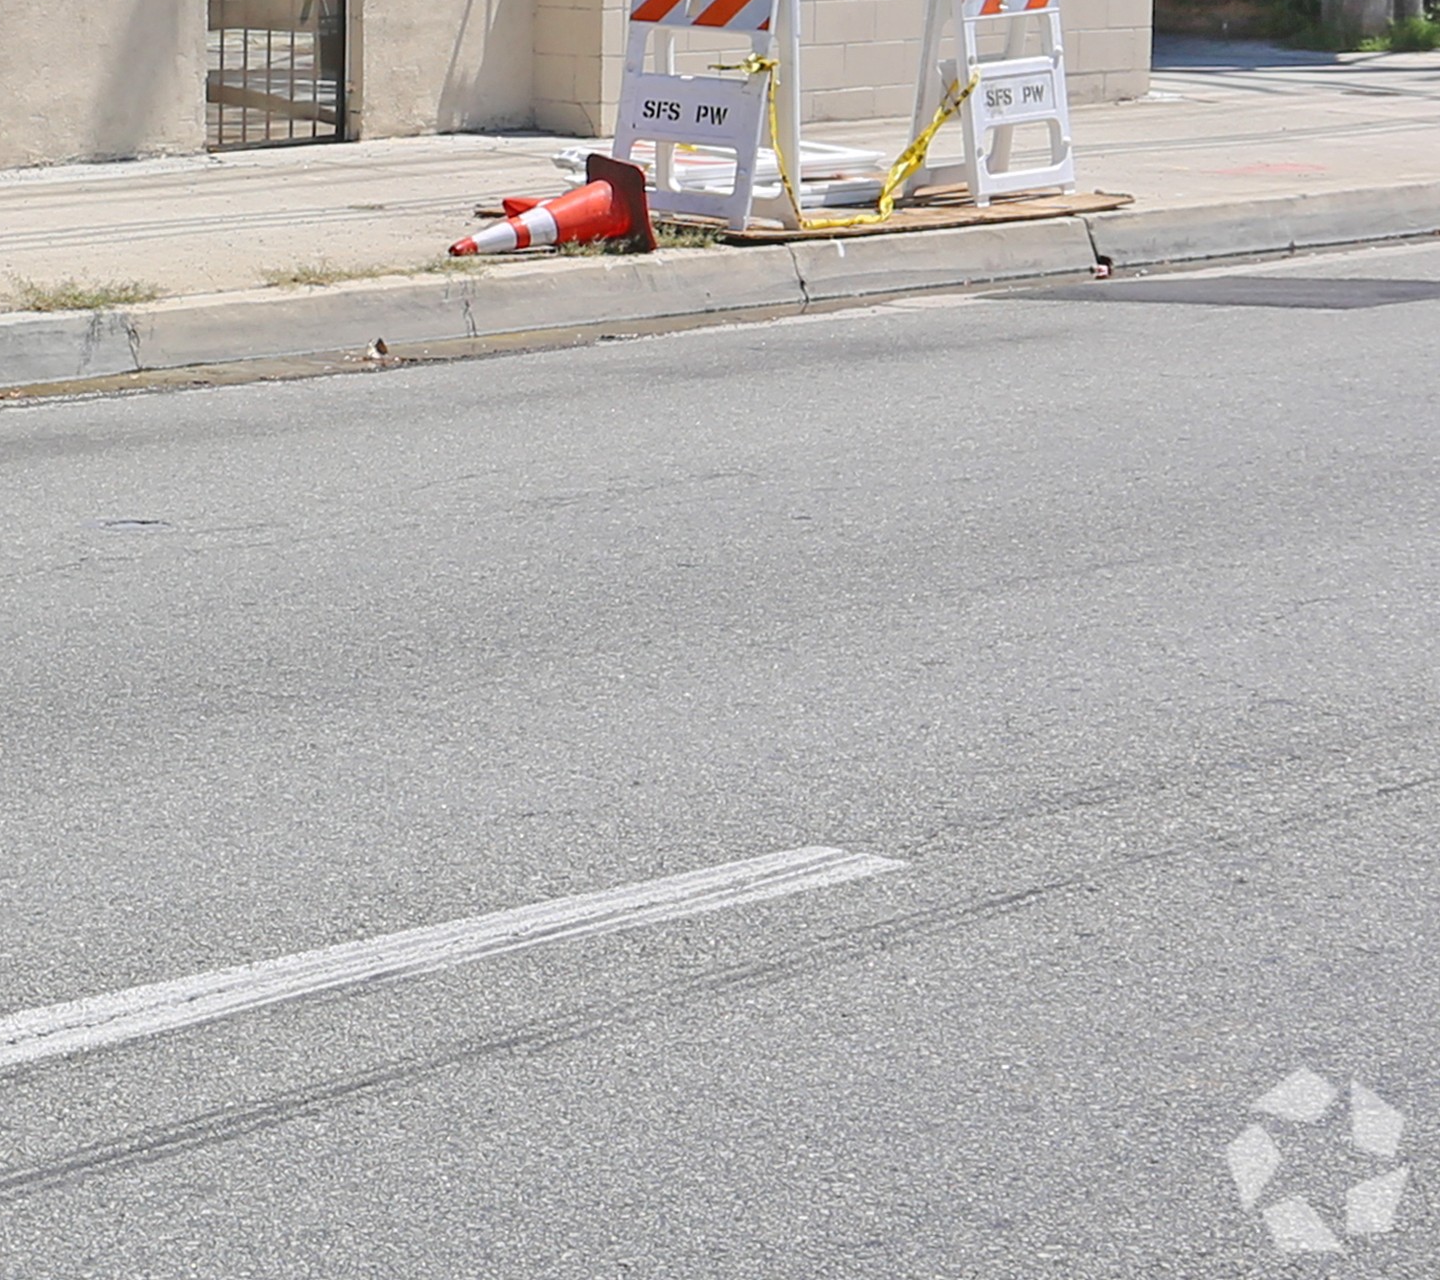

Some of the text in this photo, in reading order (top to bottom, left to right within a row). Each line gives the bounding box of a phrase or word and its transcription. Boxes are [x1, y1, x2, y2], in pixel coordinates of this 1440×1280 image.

[985, 84, 1044, 107] SFS PW
[642, 99, 728, 125] SFS PW
